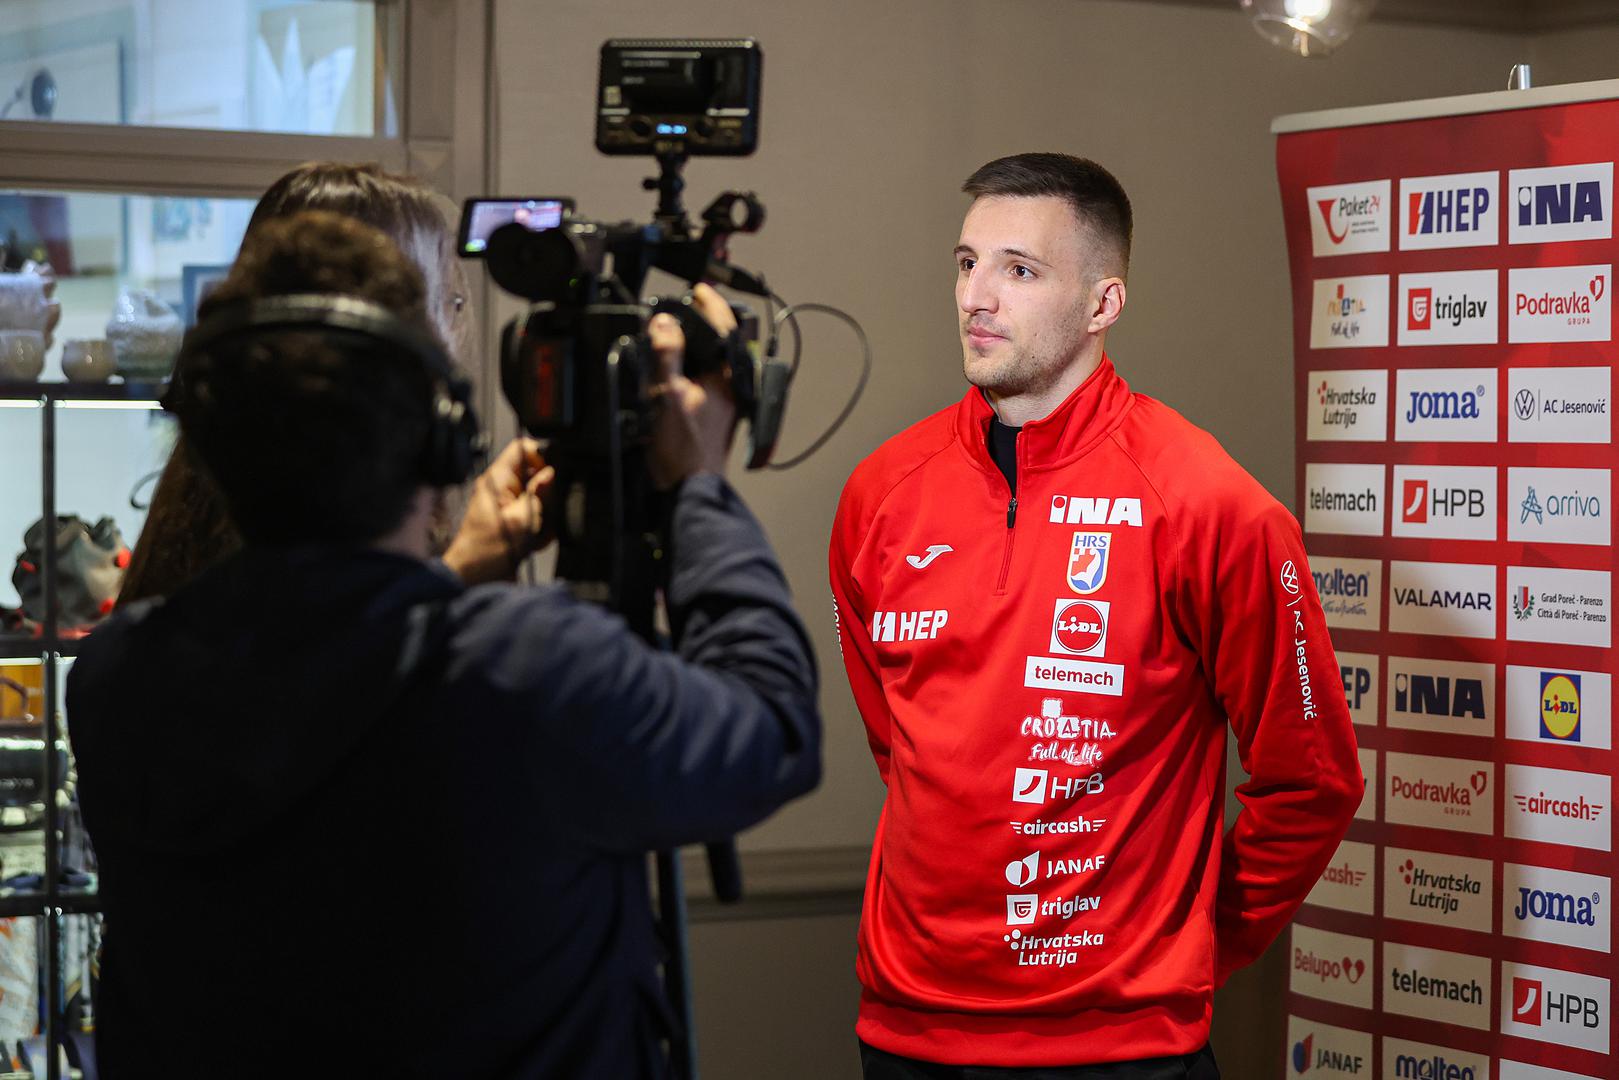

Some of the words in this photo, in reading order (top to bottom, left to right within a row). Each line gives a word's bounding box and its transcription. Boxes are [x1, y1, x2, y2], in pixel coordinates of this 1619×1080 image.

[1437, 187, 1489, 234] HEP
[1436, 295, 1487, 326] triglav
[1516, 292, 1590, 315] Podravka
[1567, 317, 1590, 325] GRUPA
[1325, 386, 1376, 405] Hrvatska
[1543, 401, 1558, 413] AC
[1560, 398, 1606, 415] Jesenović
[1323, 408, 1356, 429] Lutrija
[1310, 487, 1376, 512] telemach
[1432, 488, 1484, 517] HPB
[1547, 490, 1600, 517] arriva
[1075, 532, 1107, 548] HRS
[1394, 587, 1492, 611] VALAMAR
[1541, 593, 1557, 603] Grad
[1580, 595, 1603, 606] Parenzo
[898, 609, 948, 642] HEP
[1554, 610, 1560, 619] di
[1583, 611, 1606, 622] Parenzo
[1035, 665, 1114, 687] telemach
[1295, 638, 1318, 721] Jesenović
[1340, 666, 1370, 709] EP
[1020, 716, 1117, 739] CROATIA
[1030, 742, 1059, 760] Full
[1060, 743, 1075, 762] of
[1080, 742, 1102, 765] life
[1050, 772, 1105, 799] HPB
[1391, 775, 1471, 806] Podravka
[1444, 807, 1471, 817] GRUPA
[1528, 792, 1590, 820] aircash
[1023, 815, 1091, 835] aircash
[1046, 855, 1105, 878] JANAF
[1322, 863, 1354, 885] cash
[1412, 868, 1481, 895] Hrvatska
[1041, 896, 1101, 920] triglav
[1409, 888, 1459, 914] Lutrija
[1021, 930, 1104, 950] Hrvatska
[1018, 949, 1078, 968] Lutrija
[1294, 947, 1341, 983] Belupo
[1392, 967, 1482, 1005] telemach
[1546, 991, 1600, 1028] HPB
[1316, 1048, 1362, 1075] JANAF
